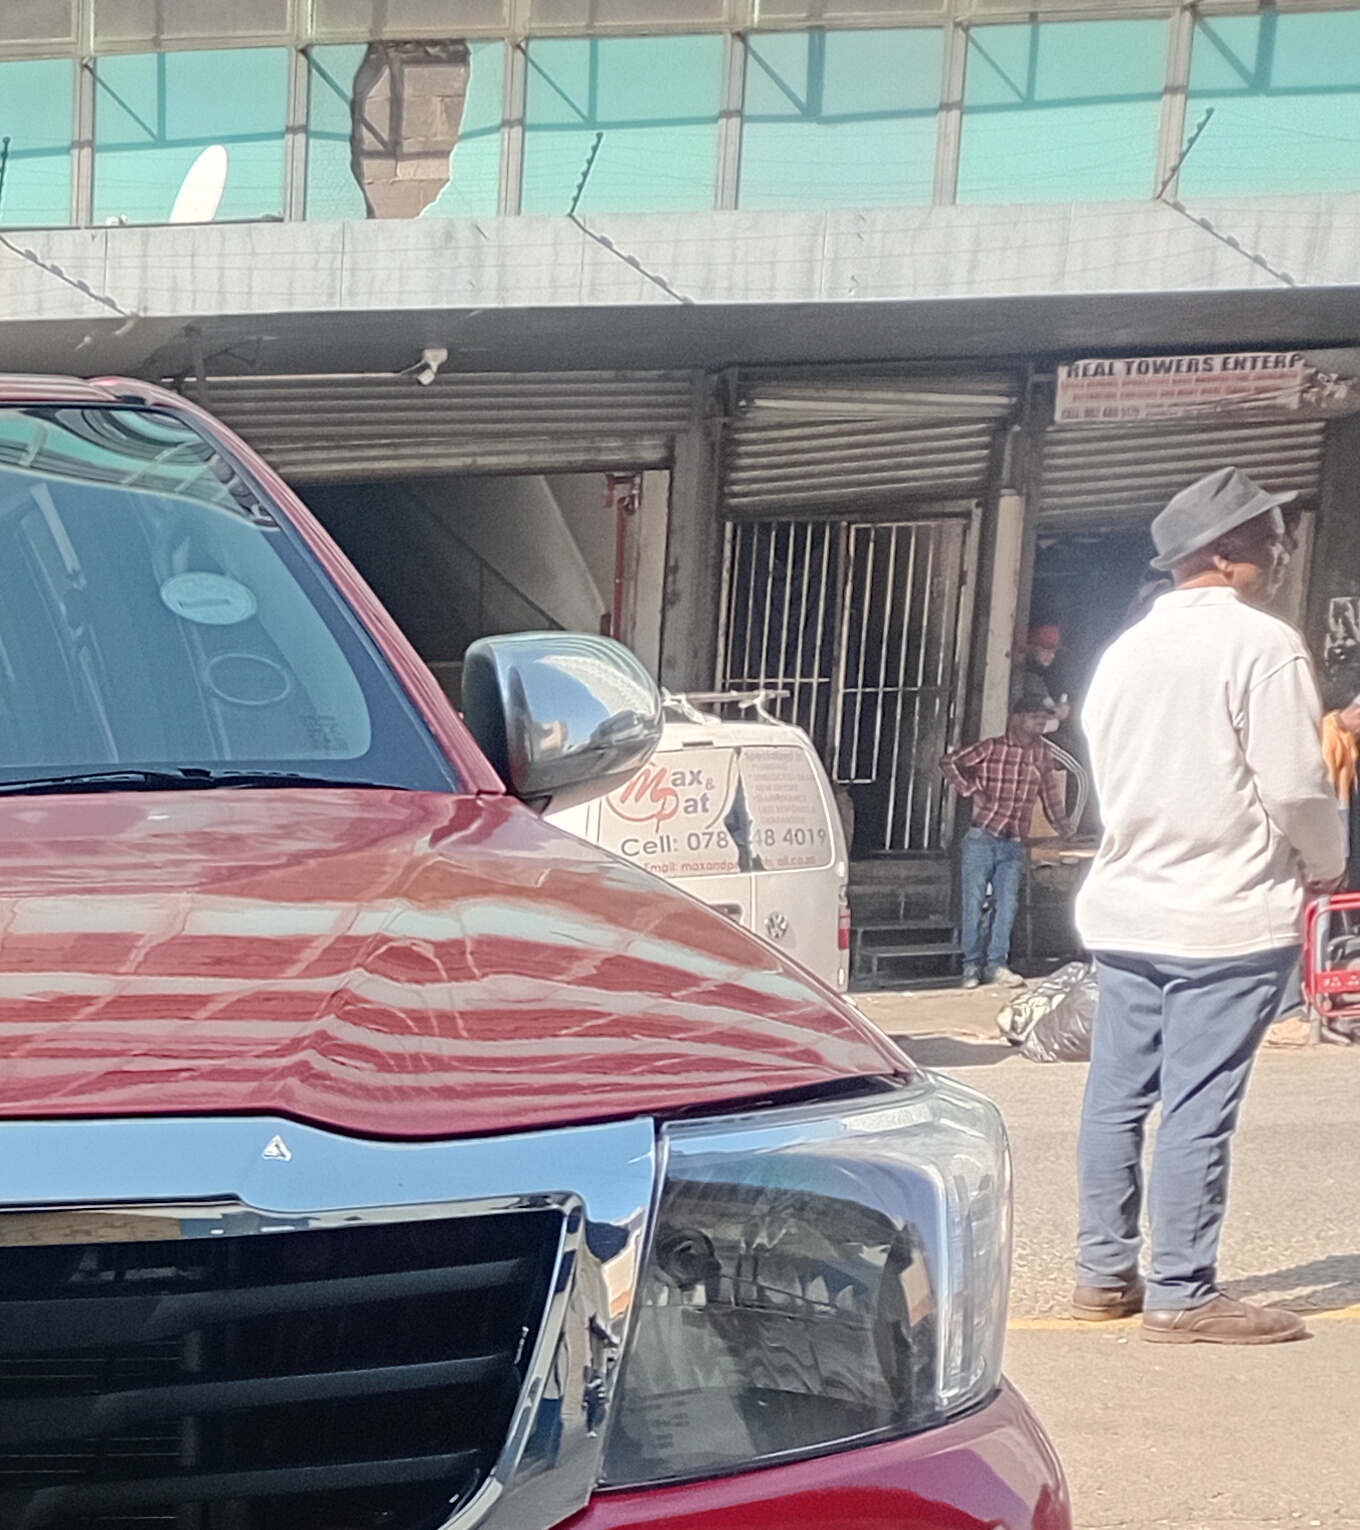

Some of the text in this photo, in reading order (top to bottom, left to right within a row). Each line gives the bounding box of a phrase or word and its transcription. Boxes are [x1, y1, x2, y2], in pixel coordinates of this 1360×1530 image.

[1066, 361, 1116, 378] REAL
[1123, 356, 1214, 376] TOWERS
[621, 835, 679, 857] Cell:
[687, 831, 729, 852] 078
[783, 827, 827, 846] 4019
